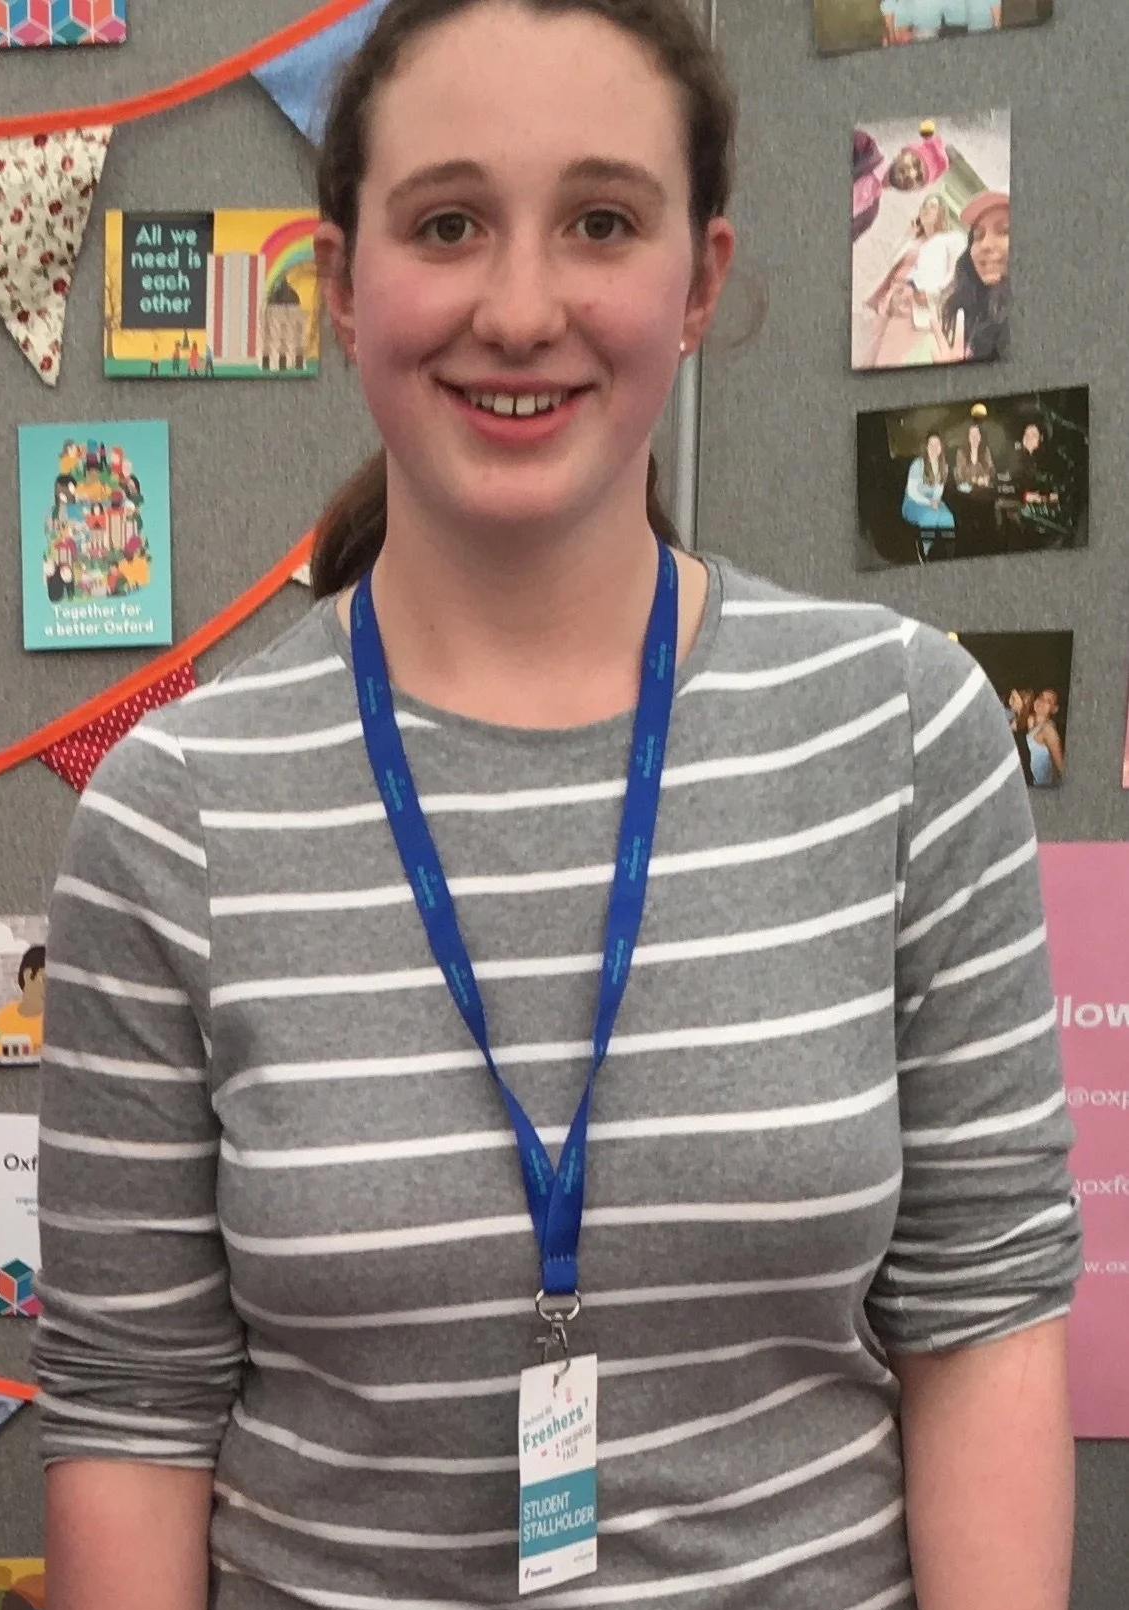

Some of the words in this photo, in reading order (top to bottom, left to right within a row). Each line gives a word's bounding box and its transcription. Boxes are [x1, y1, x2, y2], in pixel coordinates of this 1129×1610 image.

[135, 224, 162, 246] All
[170, 229, 198, 246] we
[131, 248, 179, 269] need
[188, 249, 202, 269] is
[141, 271, 190, 292] each
[139, 296, 192, 314] other
[53, 603, 117, 621] Together
[120, 602, 142, 618] for
[56, 620, 101, 637] better
[104, 617, 154, 635] Oxford
[523, 1491, 571, 1521] STUDENT
[523, 1505, 595, 1543] STALLHOLDER
